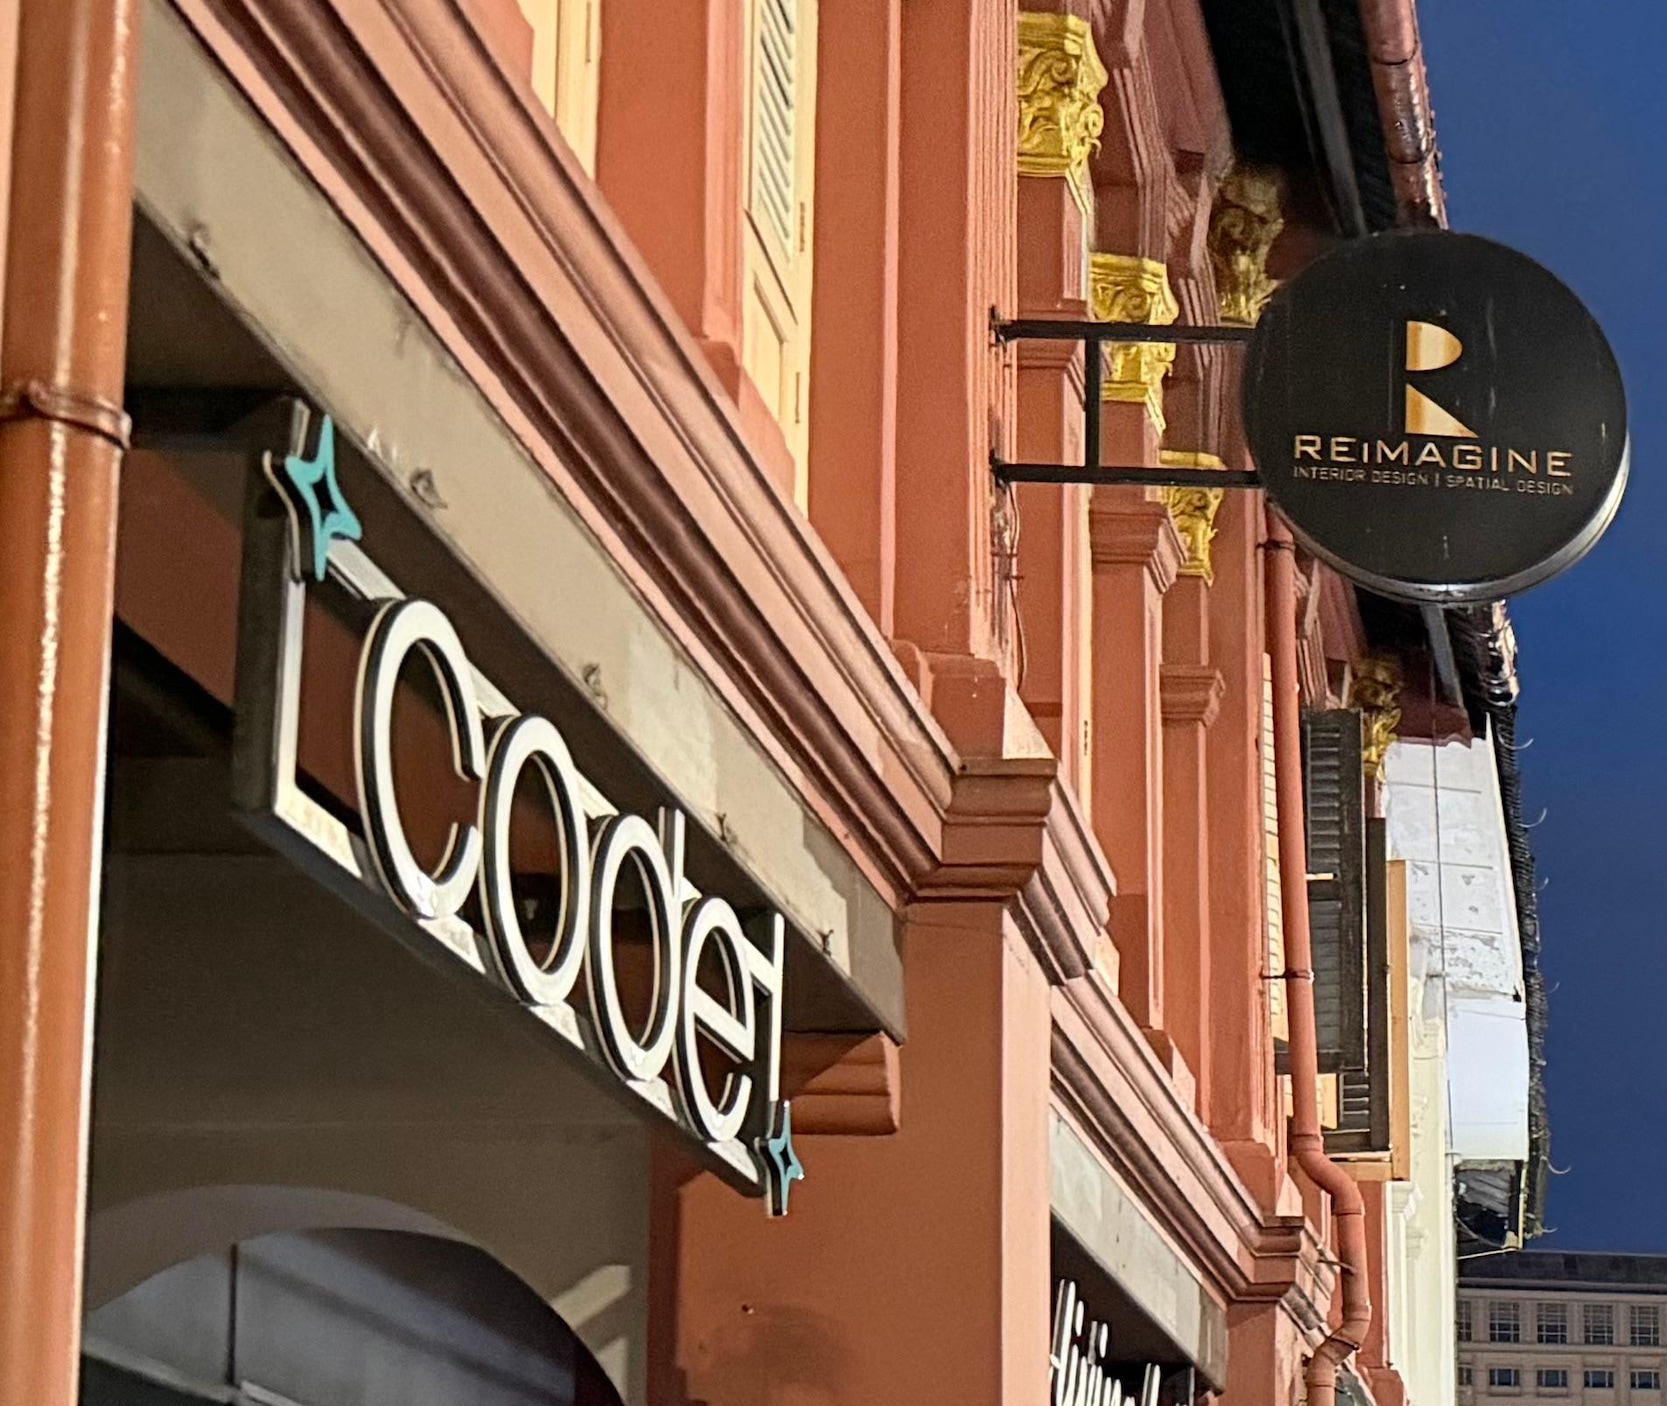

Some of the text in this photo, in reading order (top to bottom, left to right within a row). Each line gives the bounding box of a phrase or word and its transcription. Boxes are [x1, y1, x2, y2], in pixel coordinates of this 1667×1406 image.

[1293, 466, 1366, 483] INTERIOR
[1371, 469, 1429, 487] DESIGN
[1446, 474, 1510, 492] SPATIAL
[1516, 479, 1574, 496] DESIGN
